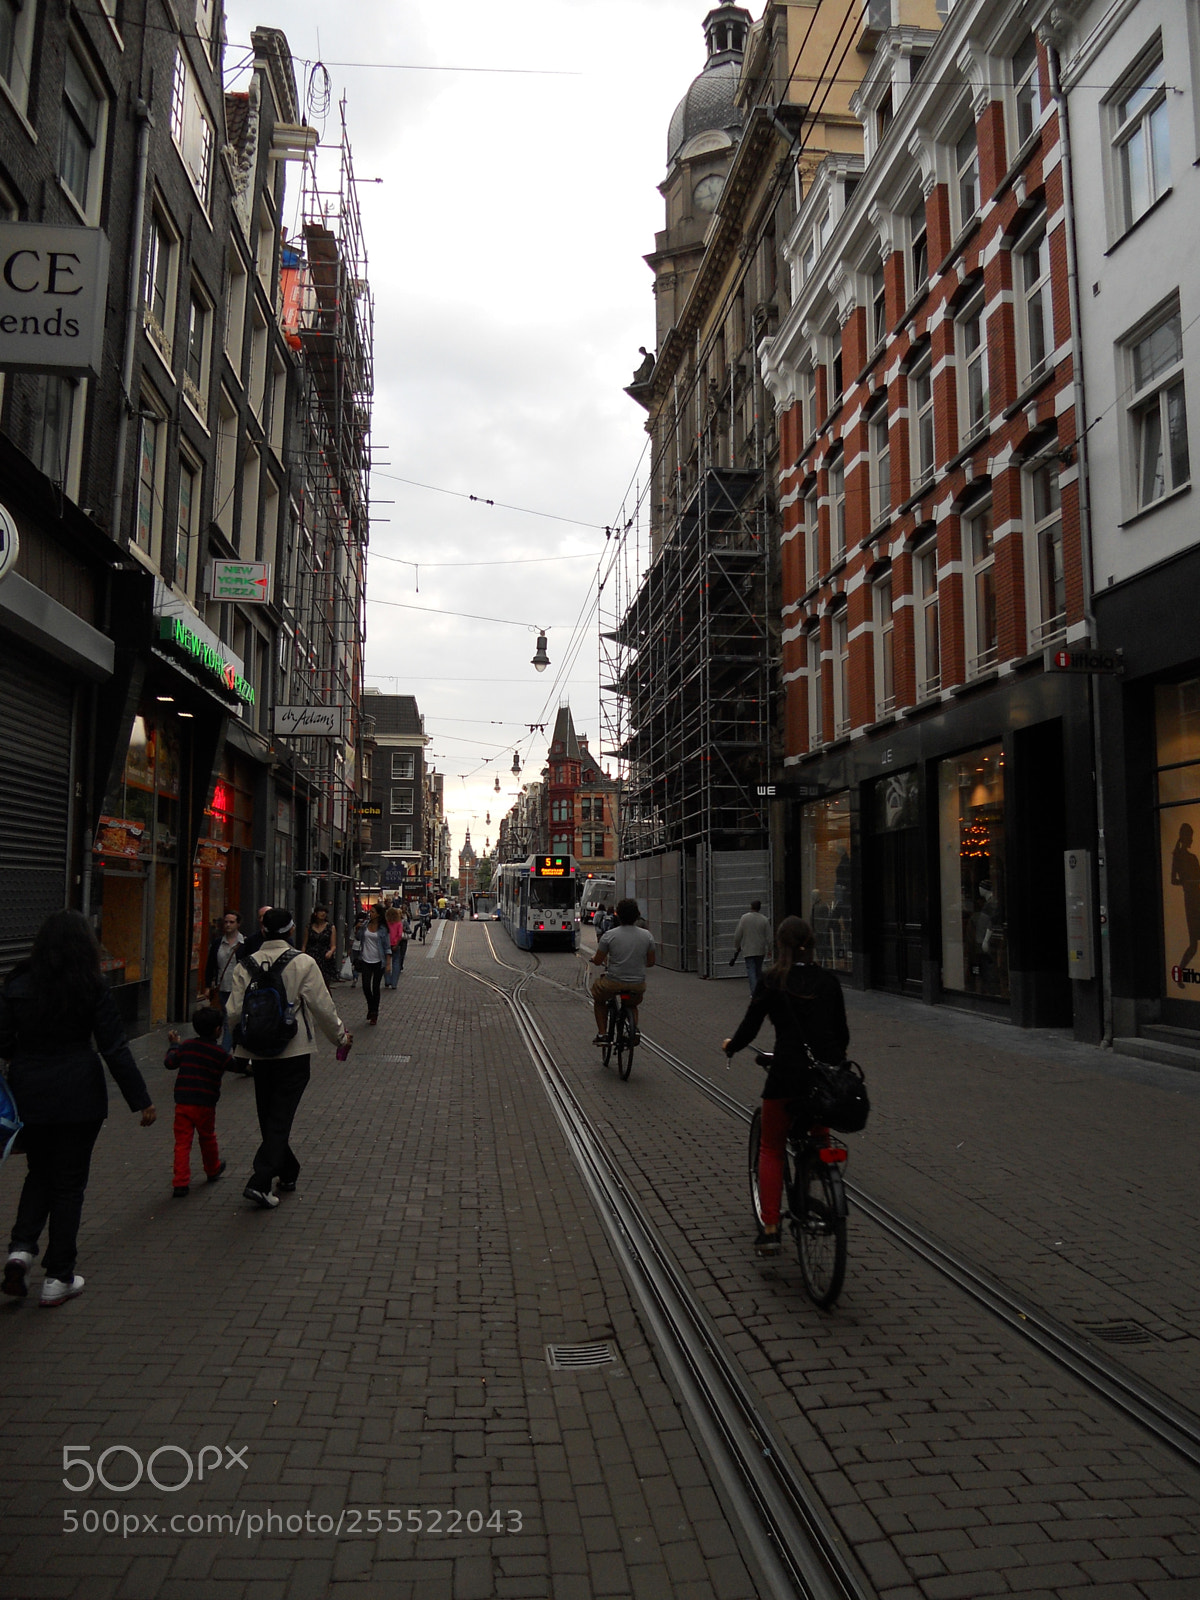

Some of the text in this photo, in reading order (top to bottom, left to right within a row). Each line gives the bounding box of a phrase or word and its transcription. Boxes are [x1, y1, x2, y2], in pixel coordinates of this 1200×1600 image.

[3, 250, 83, 295] CE
[0, 308, 80, 337] ends
[223, 565, 254, 574] NEW
[218, 576, 256, 586] YORK
[219, 587, 258, 597] PIZZA
[175, 618, 255, 706] NEW YORK PIZZA
[756, 785, 777, 796] WE
[545, 857, 551, 867] 5
